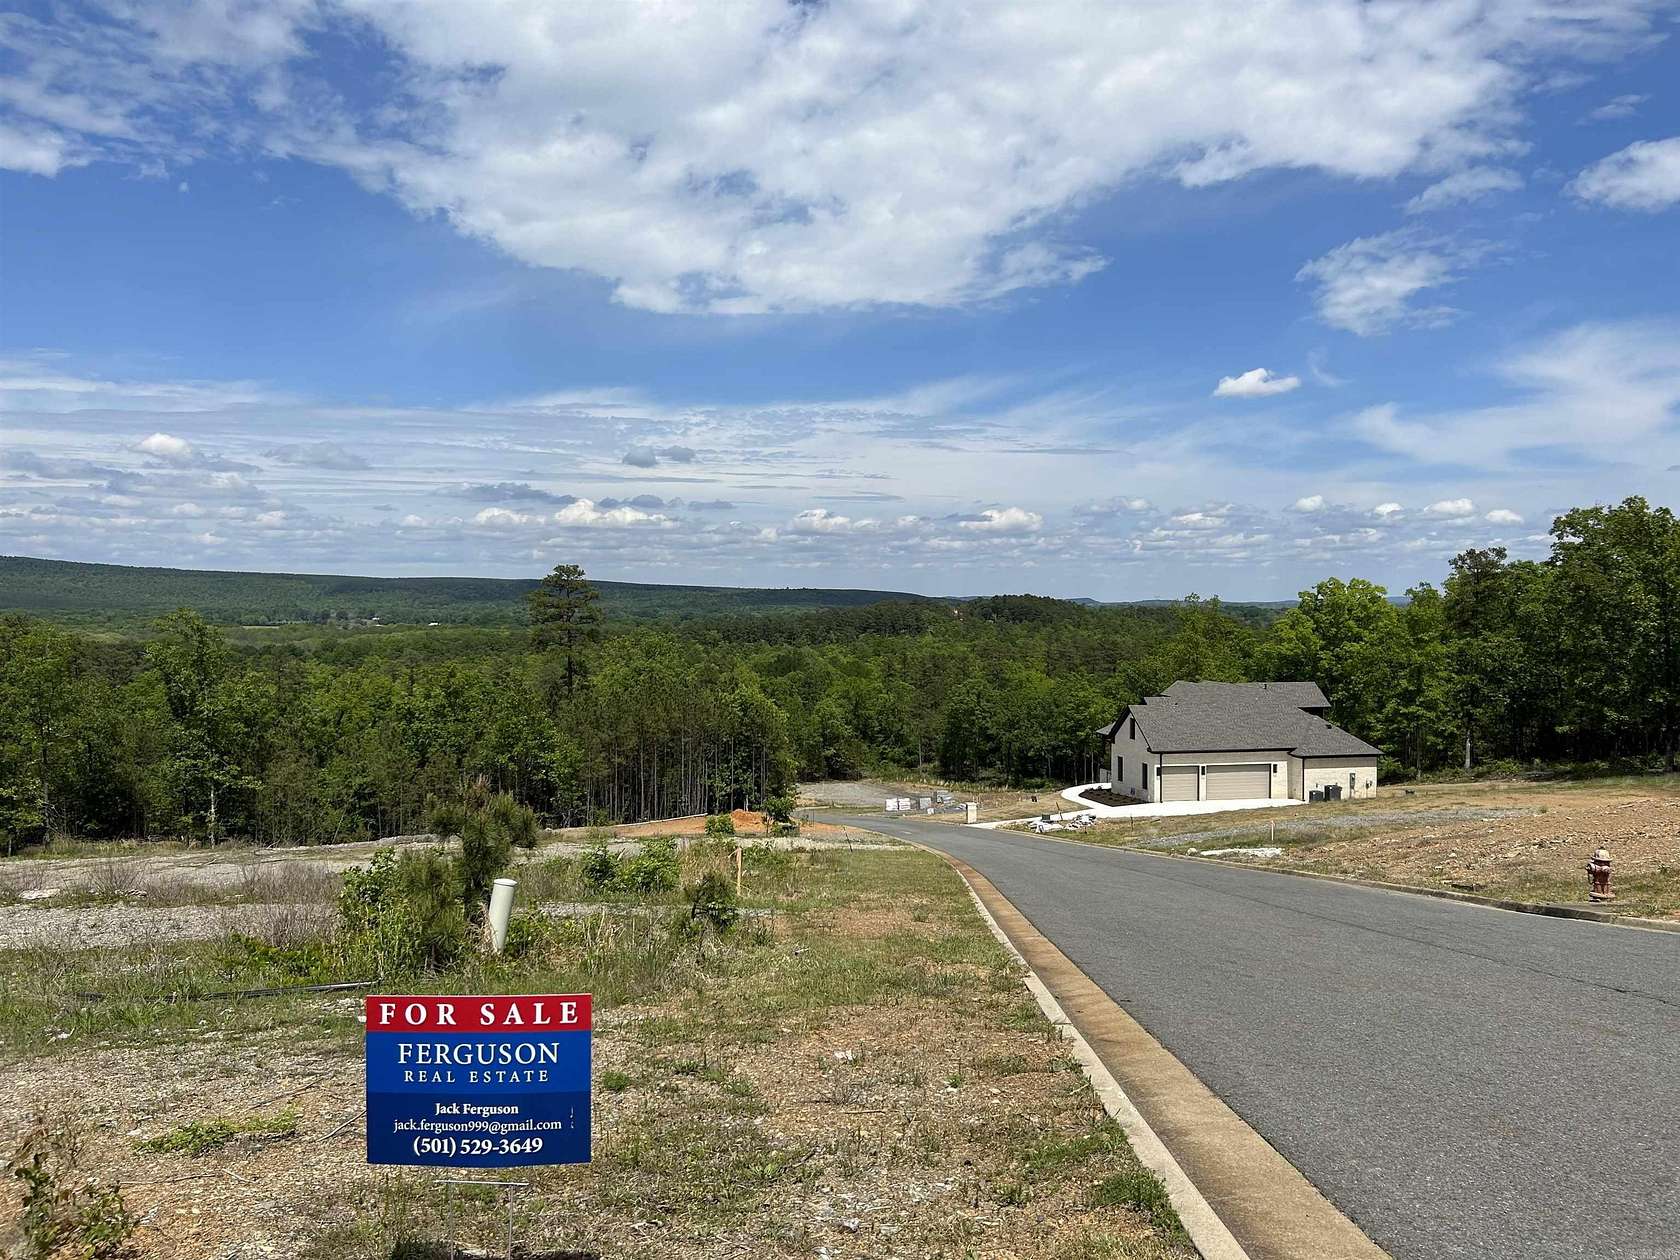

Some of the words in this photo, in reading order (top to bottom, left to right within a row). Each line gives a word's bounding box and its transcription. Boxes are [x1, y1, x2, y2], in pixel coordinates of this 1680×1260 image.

[379, 1003, 457, 1025] FOR
[480, 1002, 579, 1025] SALE
[397, 1042, 560, 1065] FERGUSON
[404, 1071, 456, 1082] REAL
[468, 1070, 548, 1083] ESTATE
[434, 1103, 461, 1116] Jack
[463, 1103, 519, 1117] Ferguson
[393, 1119, 562, 1134] jack.ferguson999@gmail.com
[413, 1137, 457, 1157] (501)
[460, 1138, 543, 1155] 529-3649
